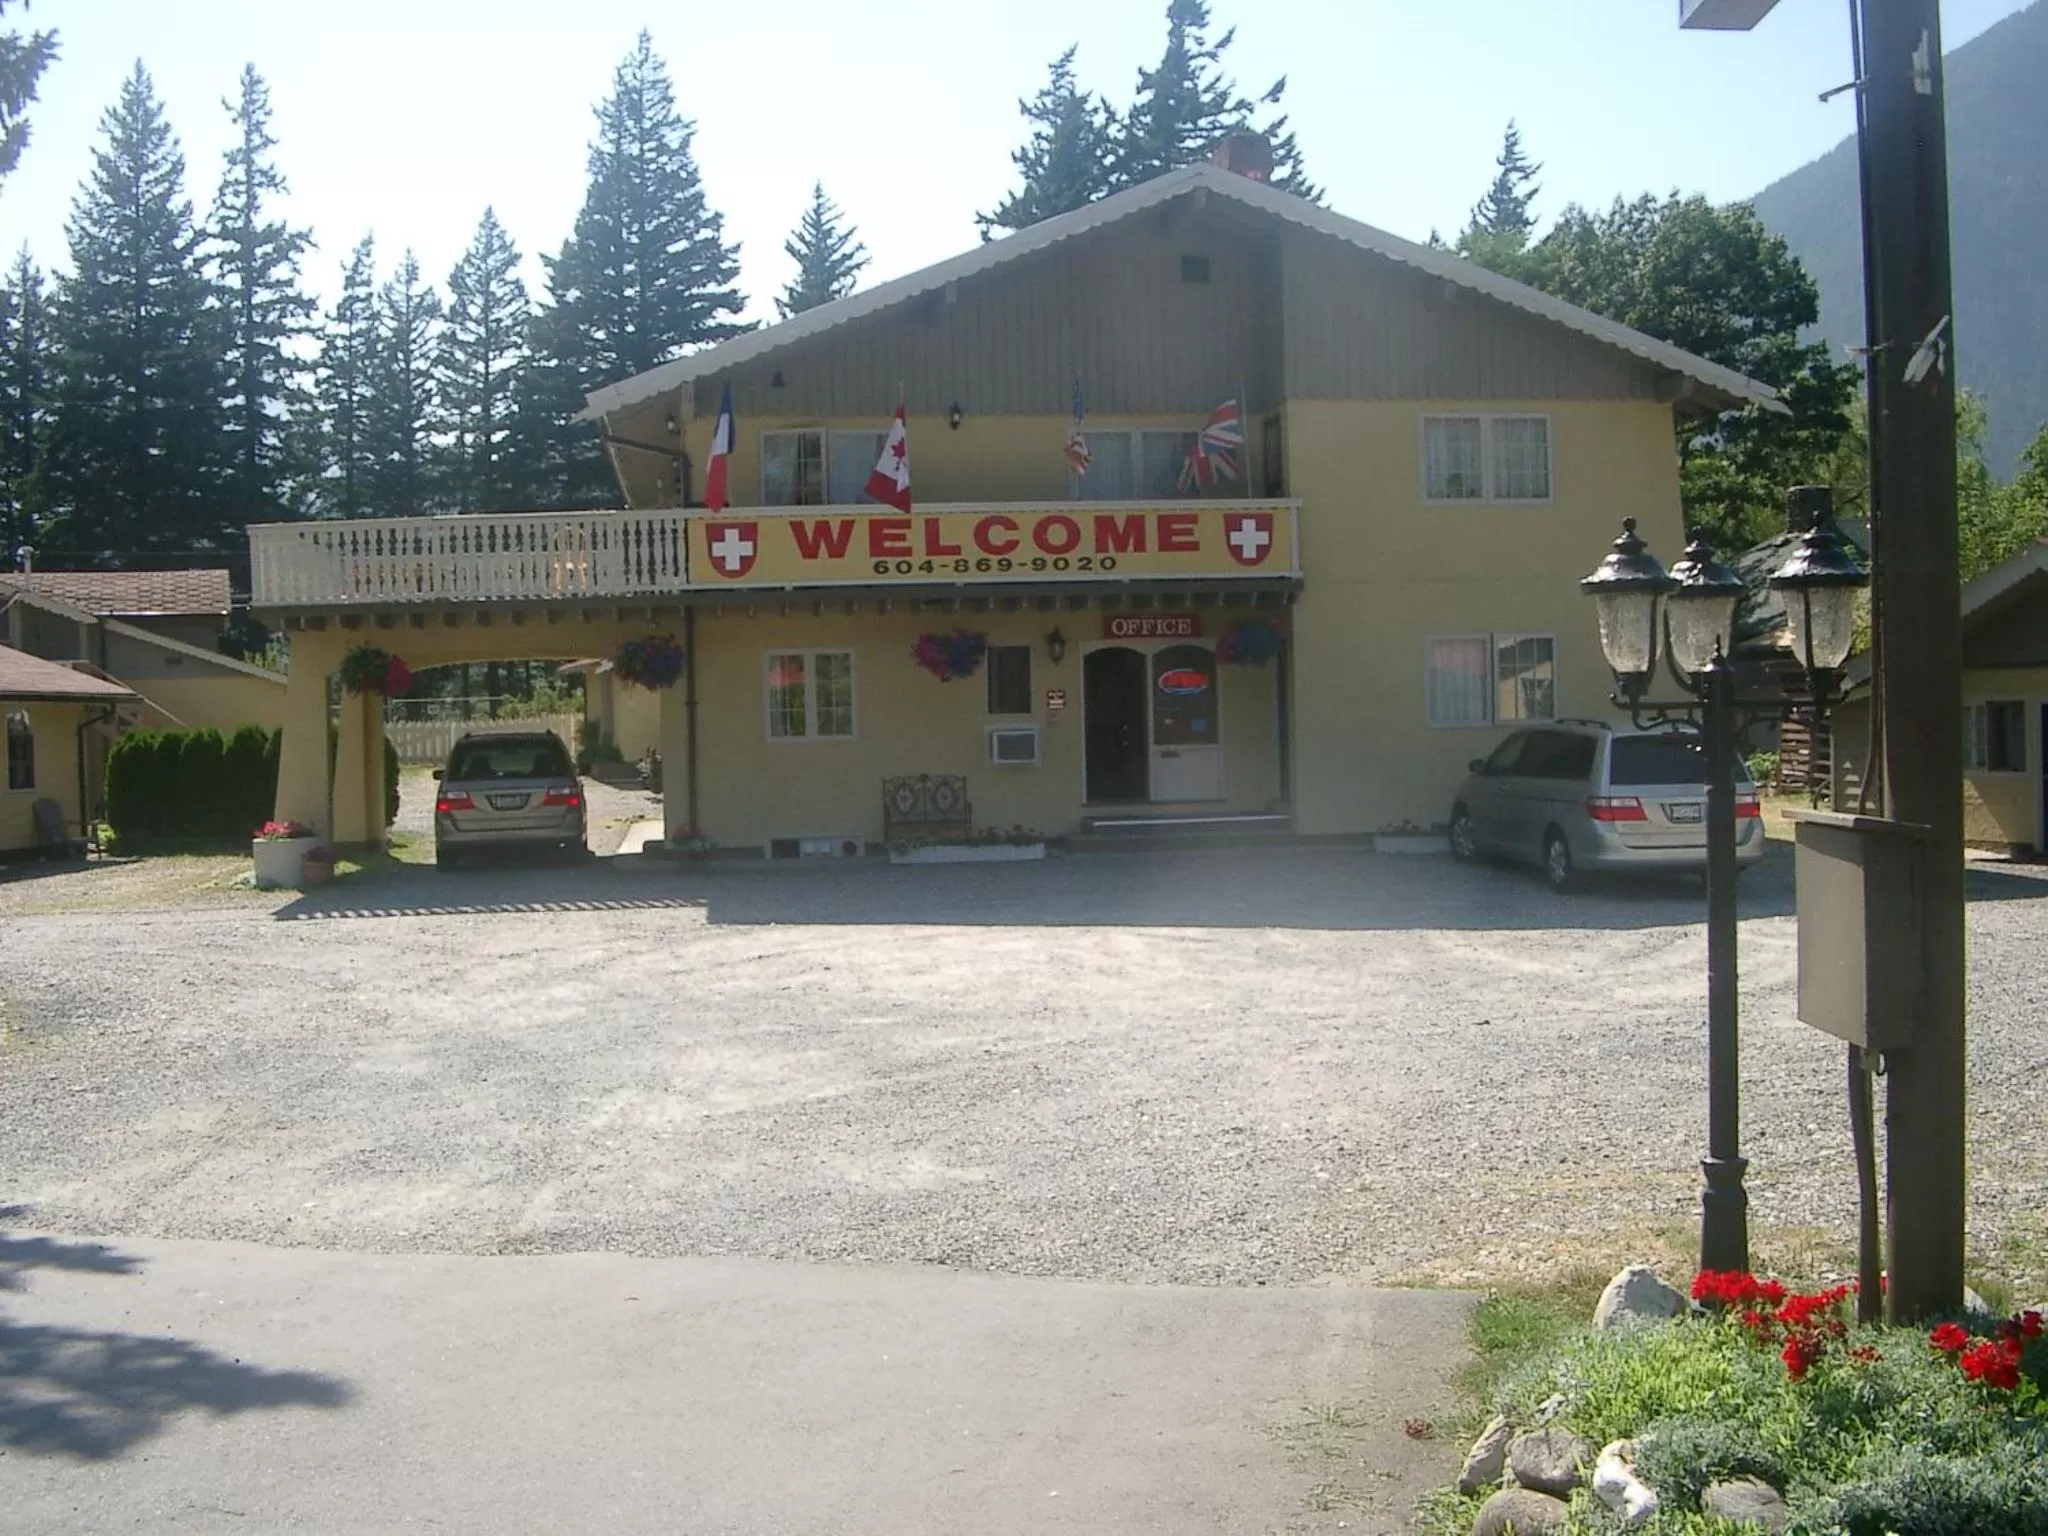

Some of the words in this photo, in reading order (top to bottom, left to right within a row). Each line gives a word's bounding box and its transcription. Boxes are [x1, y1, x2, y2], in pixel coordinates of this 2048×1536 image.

[790, 514, 1200, 559] WELCOME
[873, 556, 1118, 575] 604-869-9020
[1111, 618, 1192, 636] OFFICE
